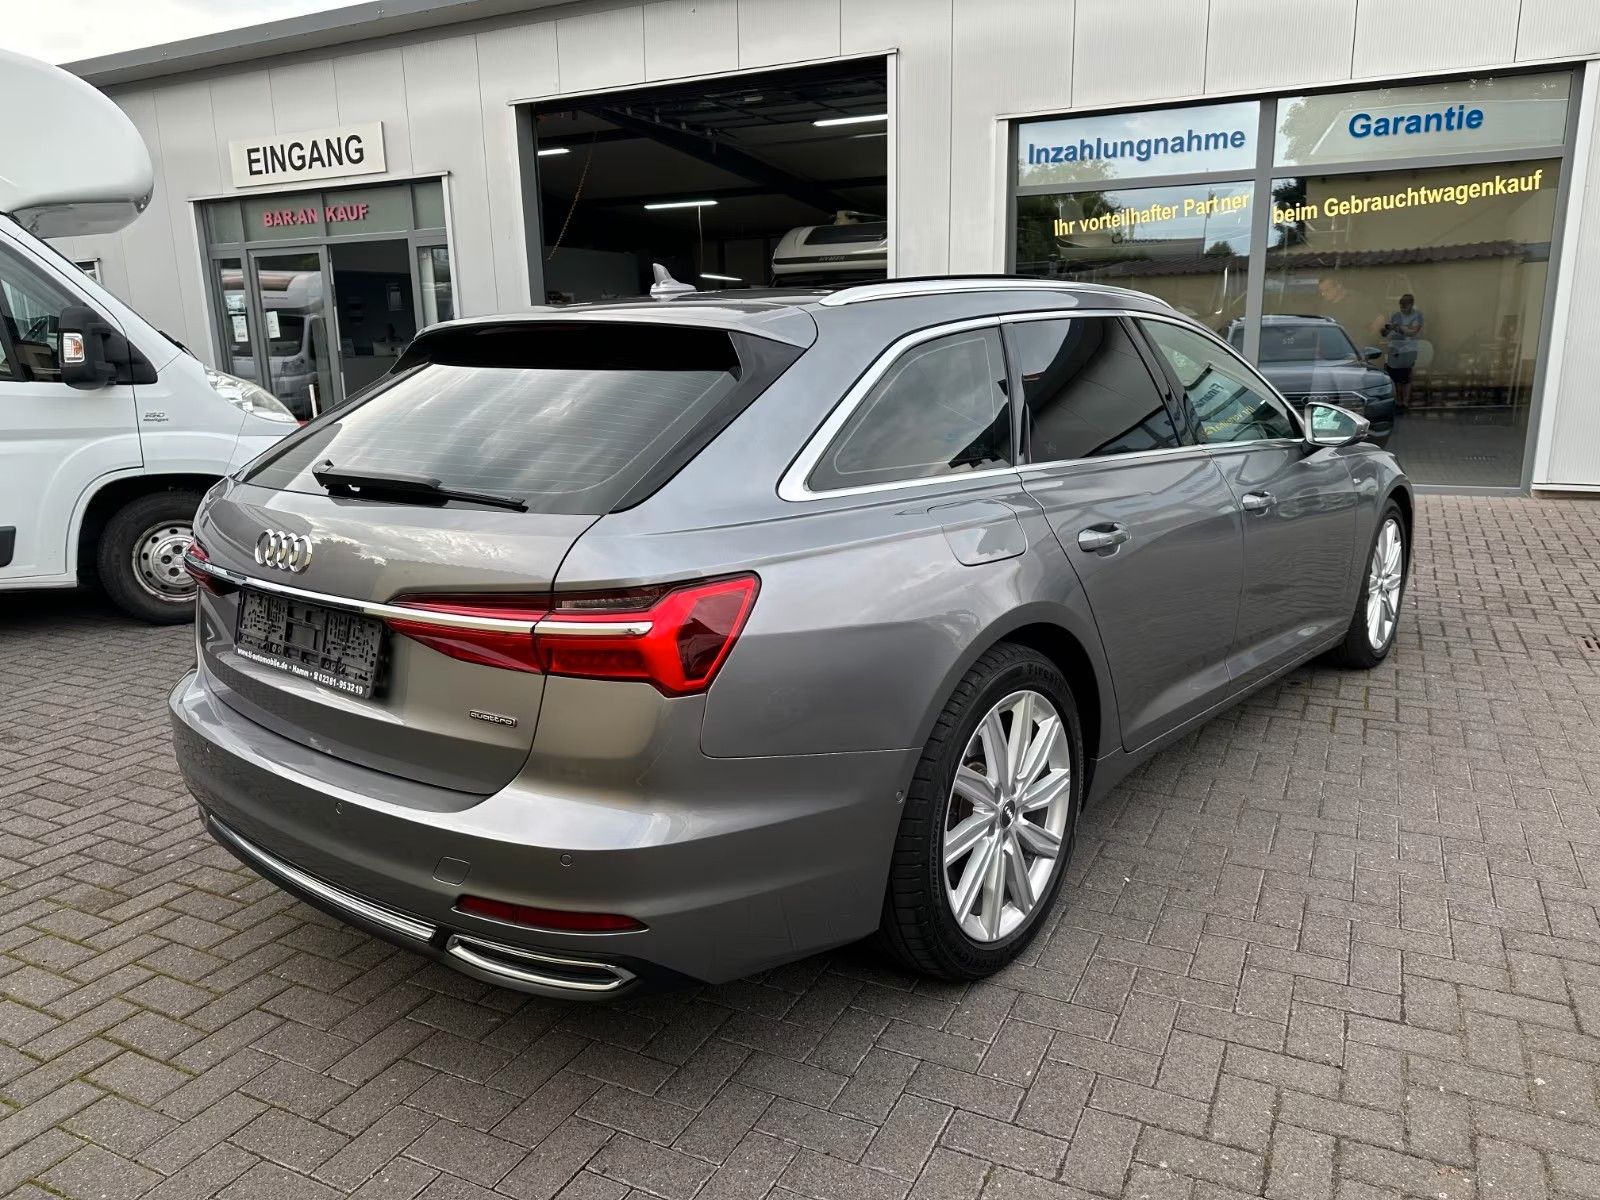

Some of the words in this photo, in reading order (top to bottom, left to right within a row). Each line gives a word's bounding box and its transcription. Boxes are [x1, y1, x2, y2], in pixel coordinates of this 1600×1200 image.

[1348, 104, 1484, 139] Garantie
[246, 134, 365, 176] EINGANG
[1027, 129, 1246, 164] Inzahlungnahme
[263, 207, 319, 228] BAR-AN
[324, 203, 369, 223] KAUF
[1054, 218, 1076, 237] Ihr
[1079, 203, 1179, 233] vorteilhafter
[1183, 192, 1249, 217] Partner
[1271, 202, 1318, 224] beim
[1323, 168, 1544, 217] Gebrauchtwagenkauf
[291, 664, 309, 679] Hamm
[318, 673, 364, 695] 02381-953219
[469, 711, 513, 726] quattro
